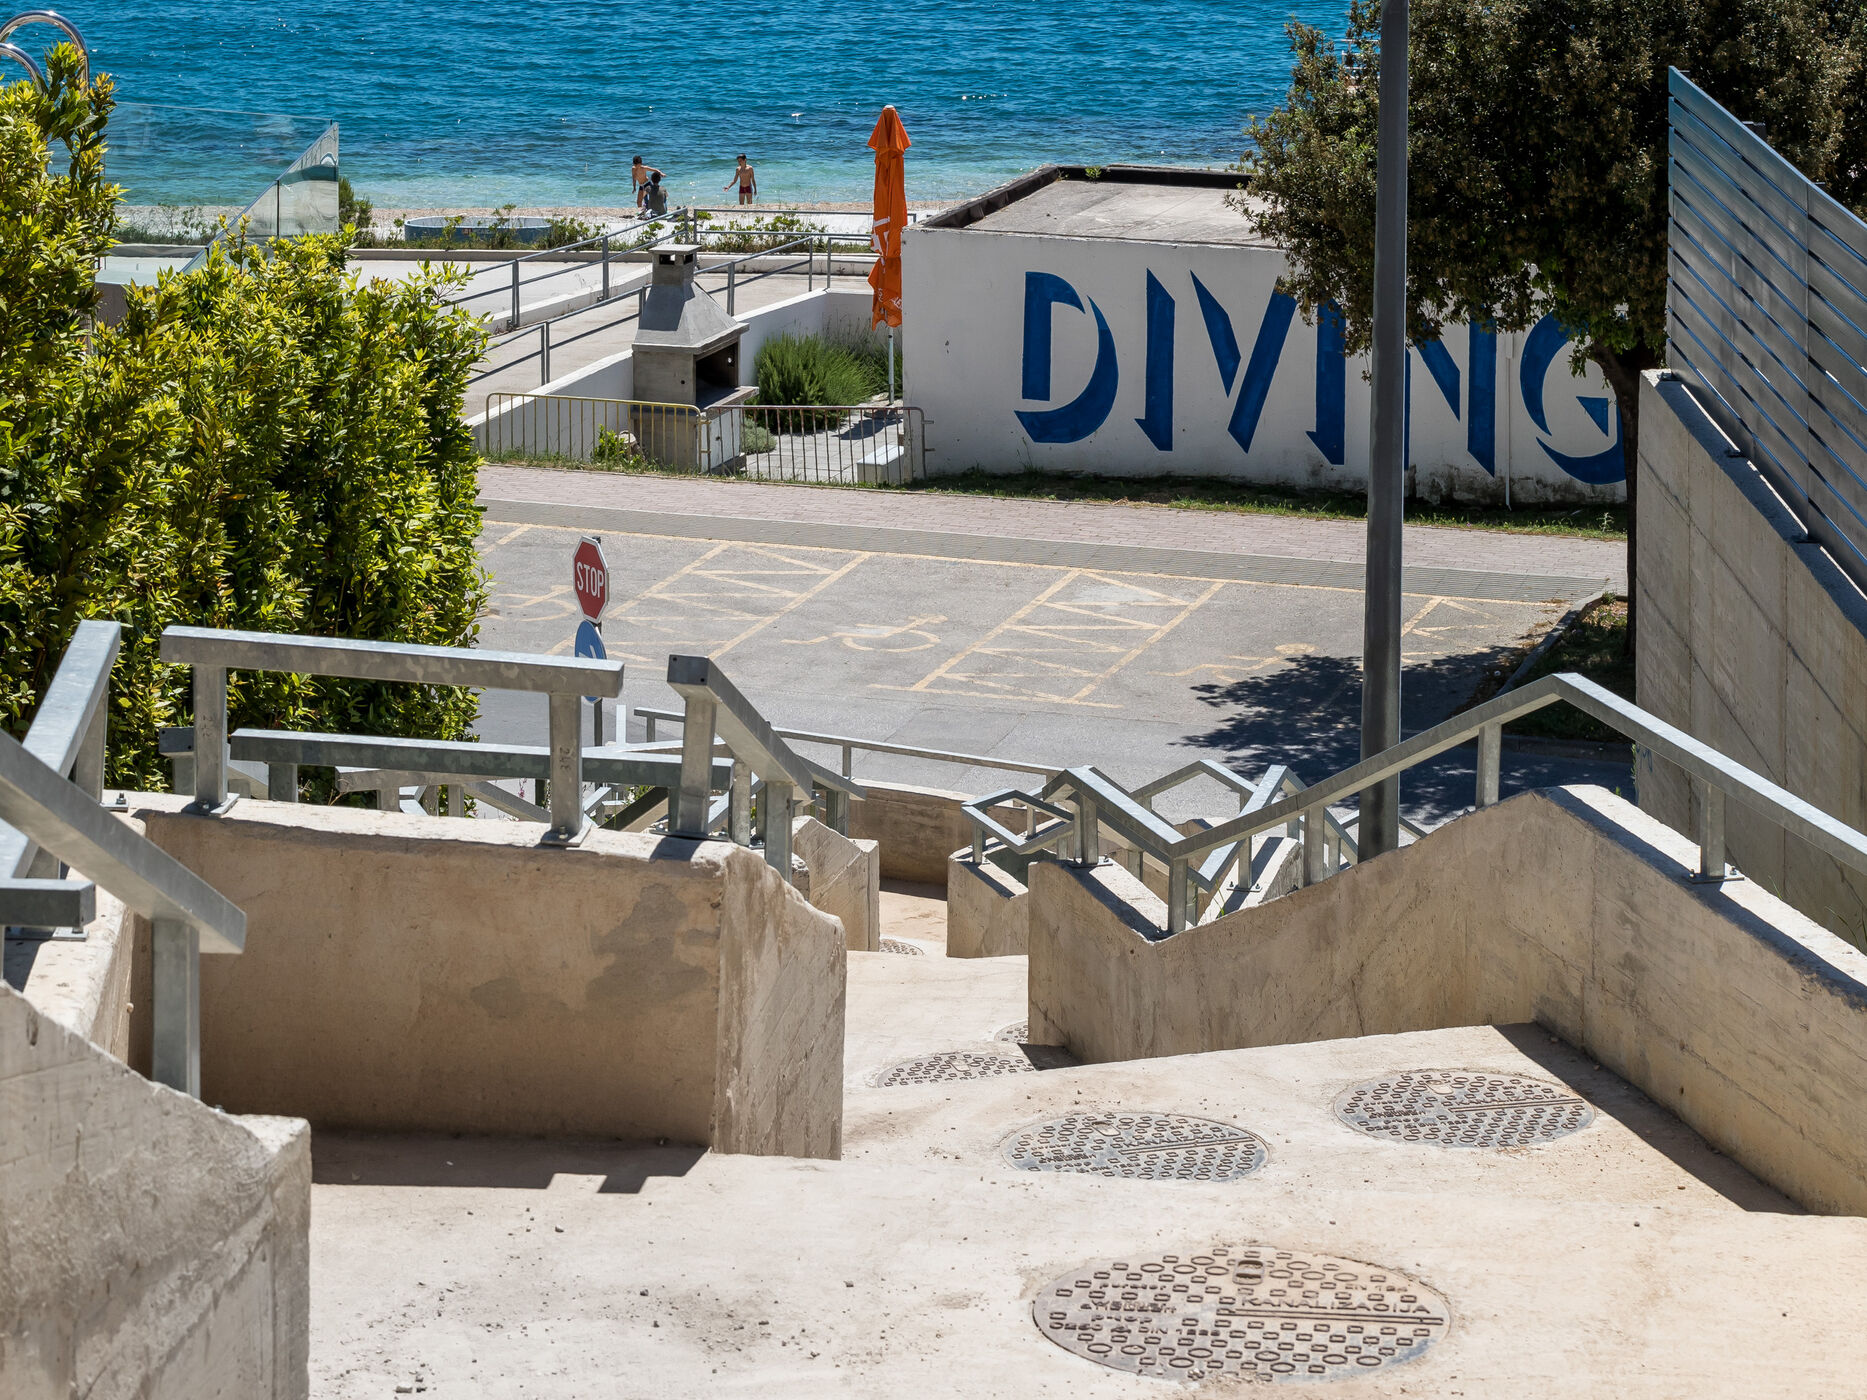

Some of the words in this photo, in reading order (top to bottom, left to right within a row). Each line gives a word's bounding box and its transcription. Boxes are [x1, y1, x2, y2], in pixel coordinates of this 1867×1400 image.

[1014, 268, 1626, 485] DIVING
[577, 561, 604, 598] STOP
[1454, 1093, 1571, 1106] KANALIZACIJA
[1123, 1131, 1240, 1148] KANALIZACIJA
[1241, 1296, 1431, 1314] KANALIZACIJA
